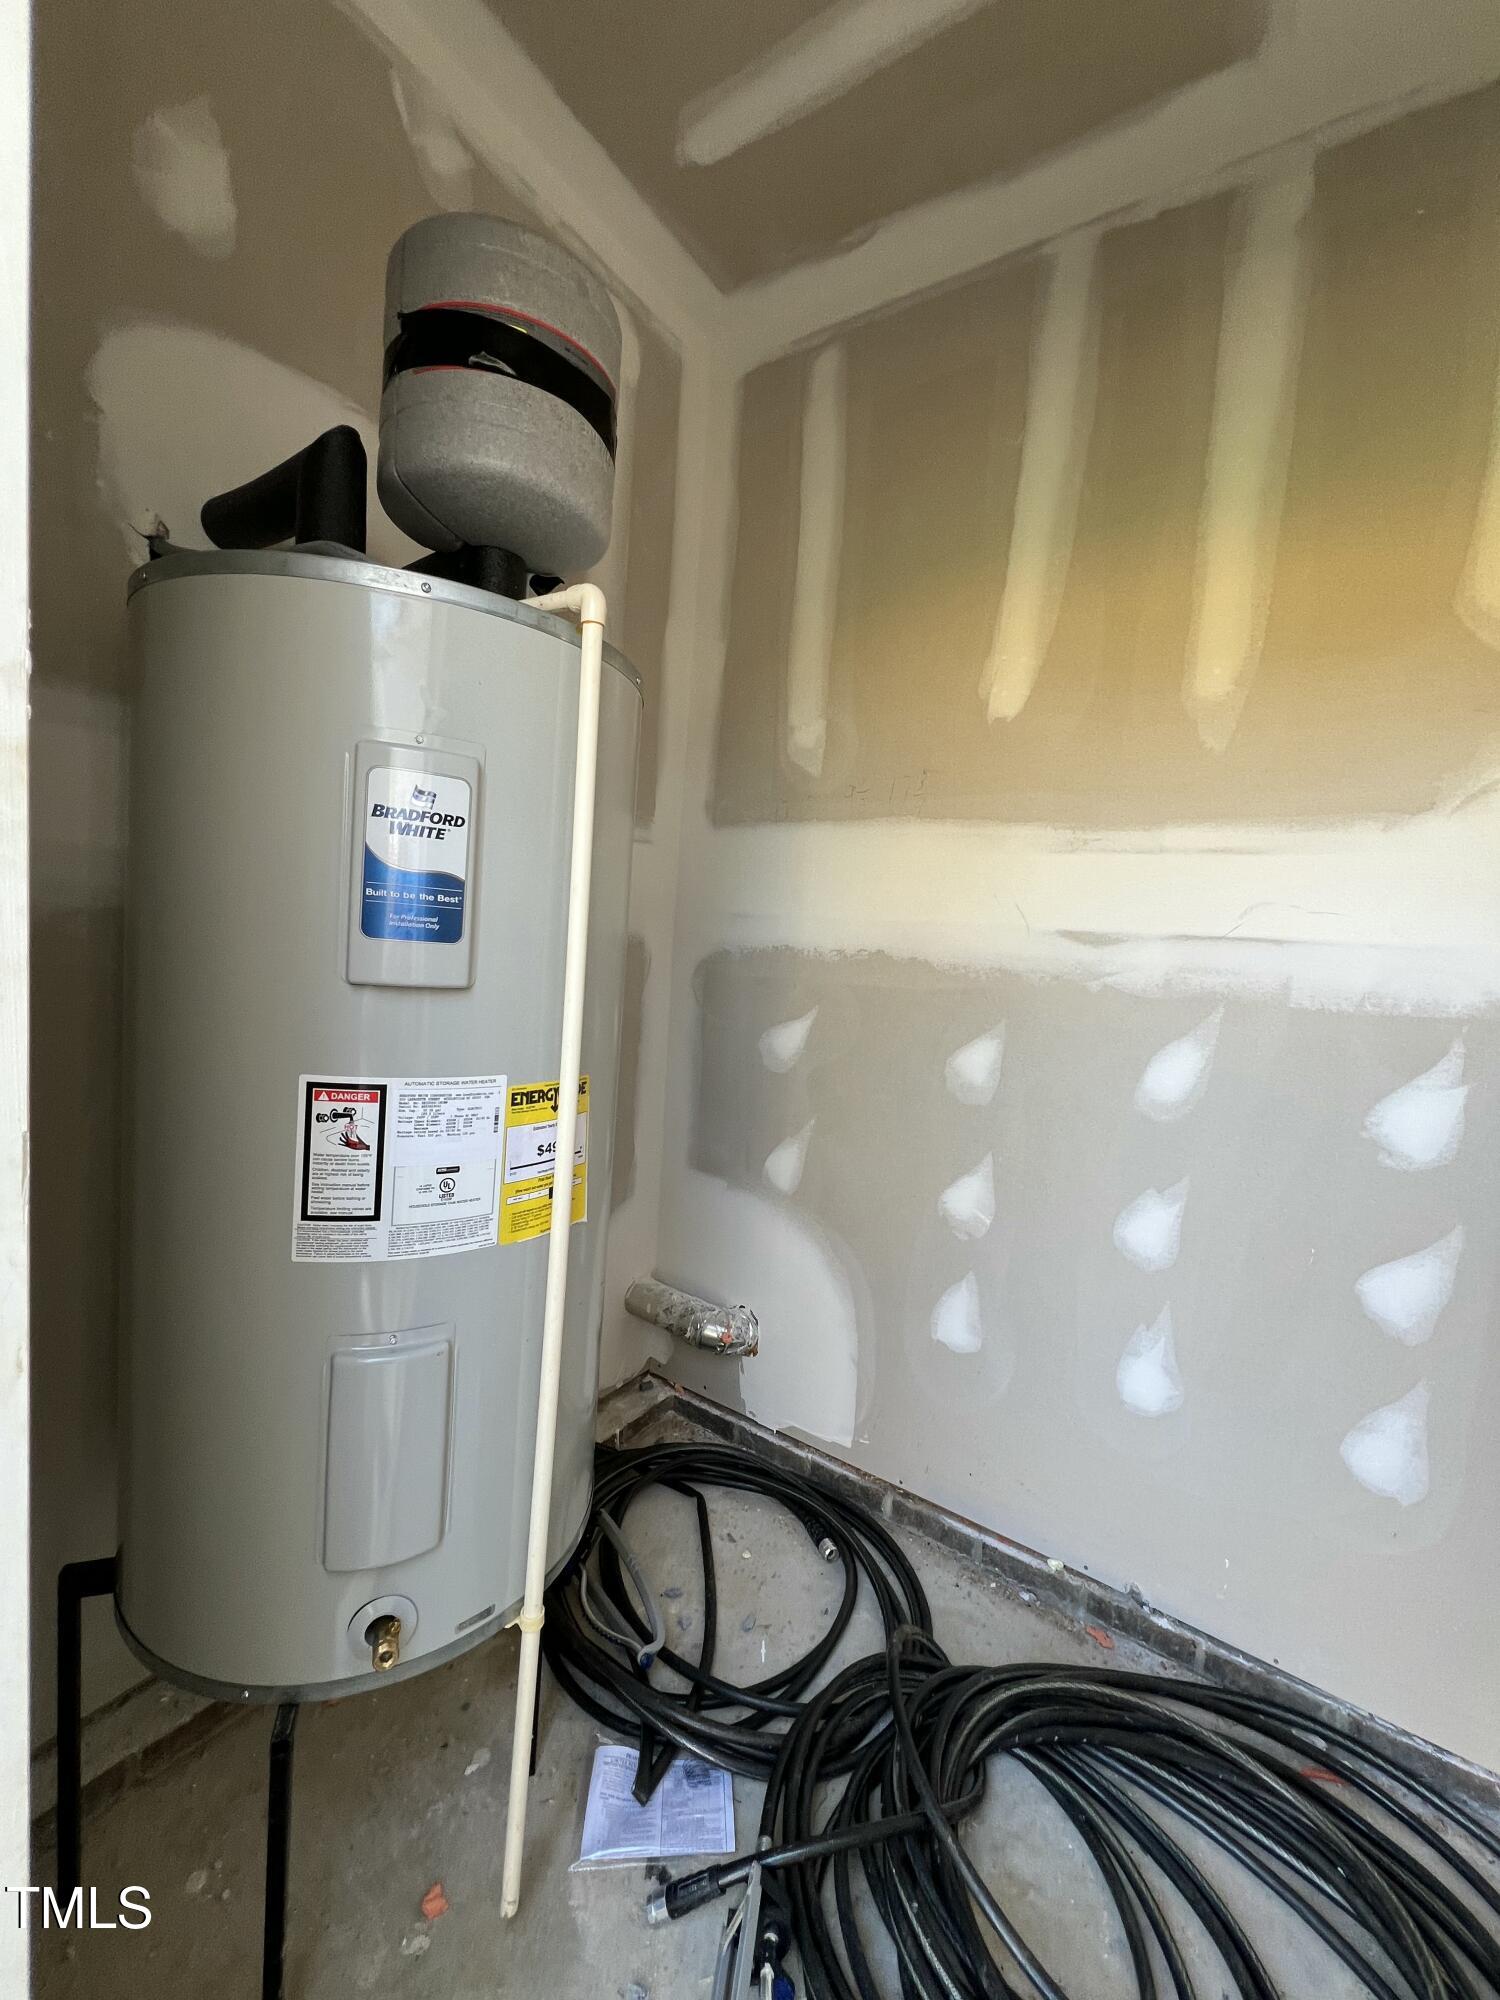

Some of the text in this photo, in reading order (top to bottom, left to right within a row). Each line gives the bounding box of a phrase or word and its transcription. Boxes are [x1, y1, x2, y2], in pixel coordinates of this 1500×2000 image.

[371, 803, 466, 827] BRADFORD
[365, 887, 388, 897] Built
[403, 891, 416, 899] be
[419, 893, 435, 901] the
[400, 914, 439, 922] Professional
[388, 920, 440, 930] Installation Only
[330, 1092, 371, 1101] DANGER
[443, 1180, 452, 1190] UL
